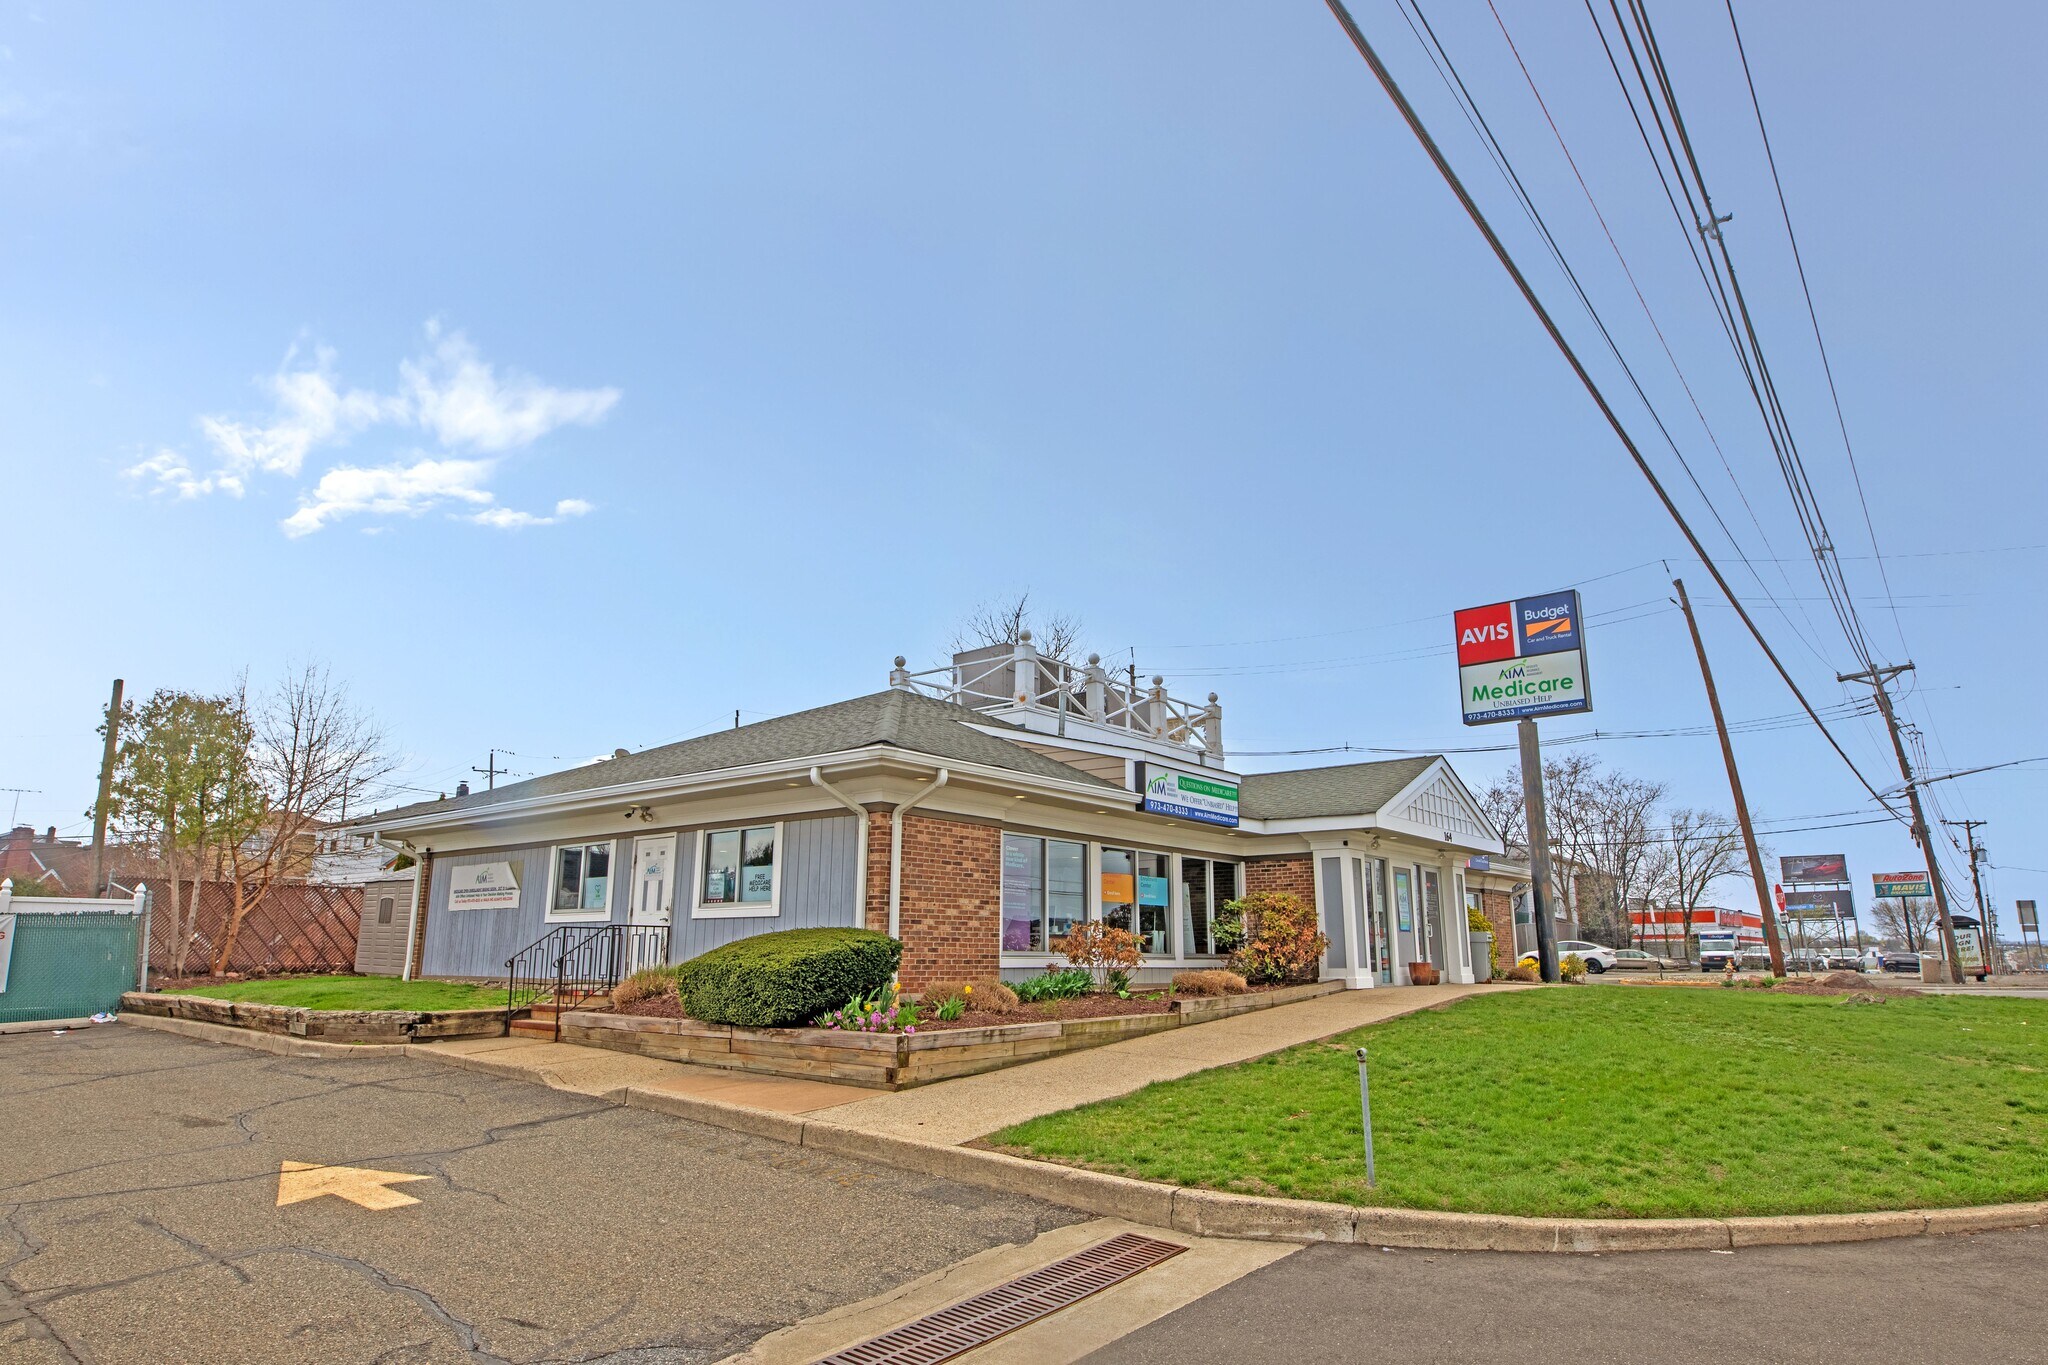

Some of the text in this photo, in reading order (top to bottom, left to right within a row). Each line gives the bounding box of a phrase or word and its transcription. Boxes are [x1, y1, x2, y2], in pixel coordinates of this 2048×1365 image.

[1524, 603, 1570, 621] Budget
[1460, 623, 1509, 646] AVIS
[1527, 636, 1536, 644] Car
[1557, 631, 1572, 640] Rental
[1472, 676, 1574, 702] Medicare
[1493, 694, 1553, 709] UNBIASED HELP
[1468, 700, 1583, 720] 973-470-8333 www.AimMedicare.com
[1180, 778, 1203, 791] QUESTIONS
[1149, 800, 1238, 824] 973-470-8333 www.AimMedicare.com
[1443, 831, 1453, 843] 164
[1883, 872, 1925, 882] AutoZone
[1891, 883, 1927, 892] MAVIS
[1776, 892, 1785, 904] STOP
